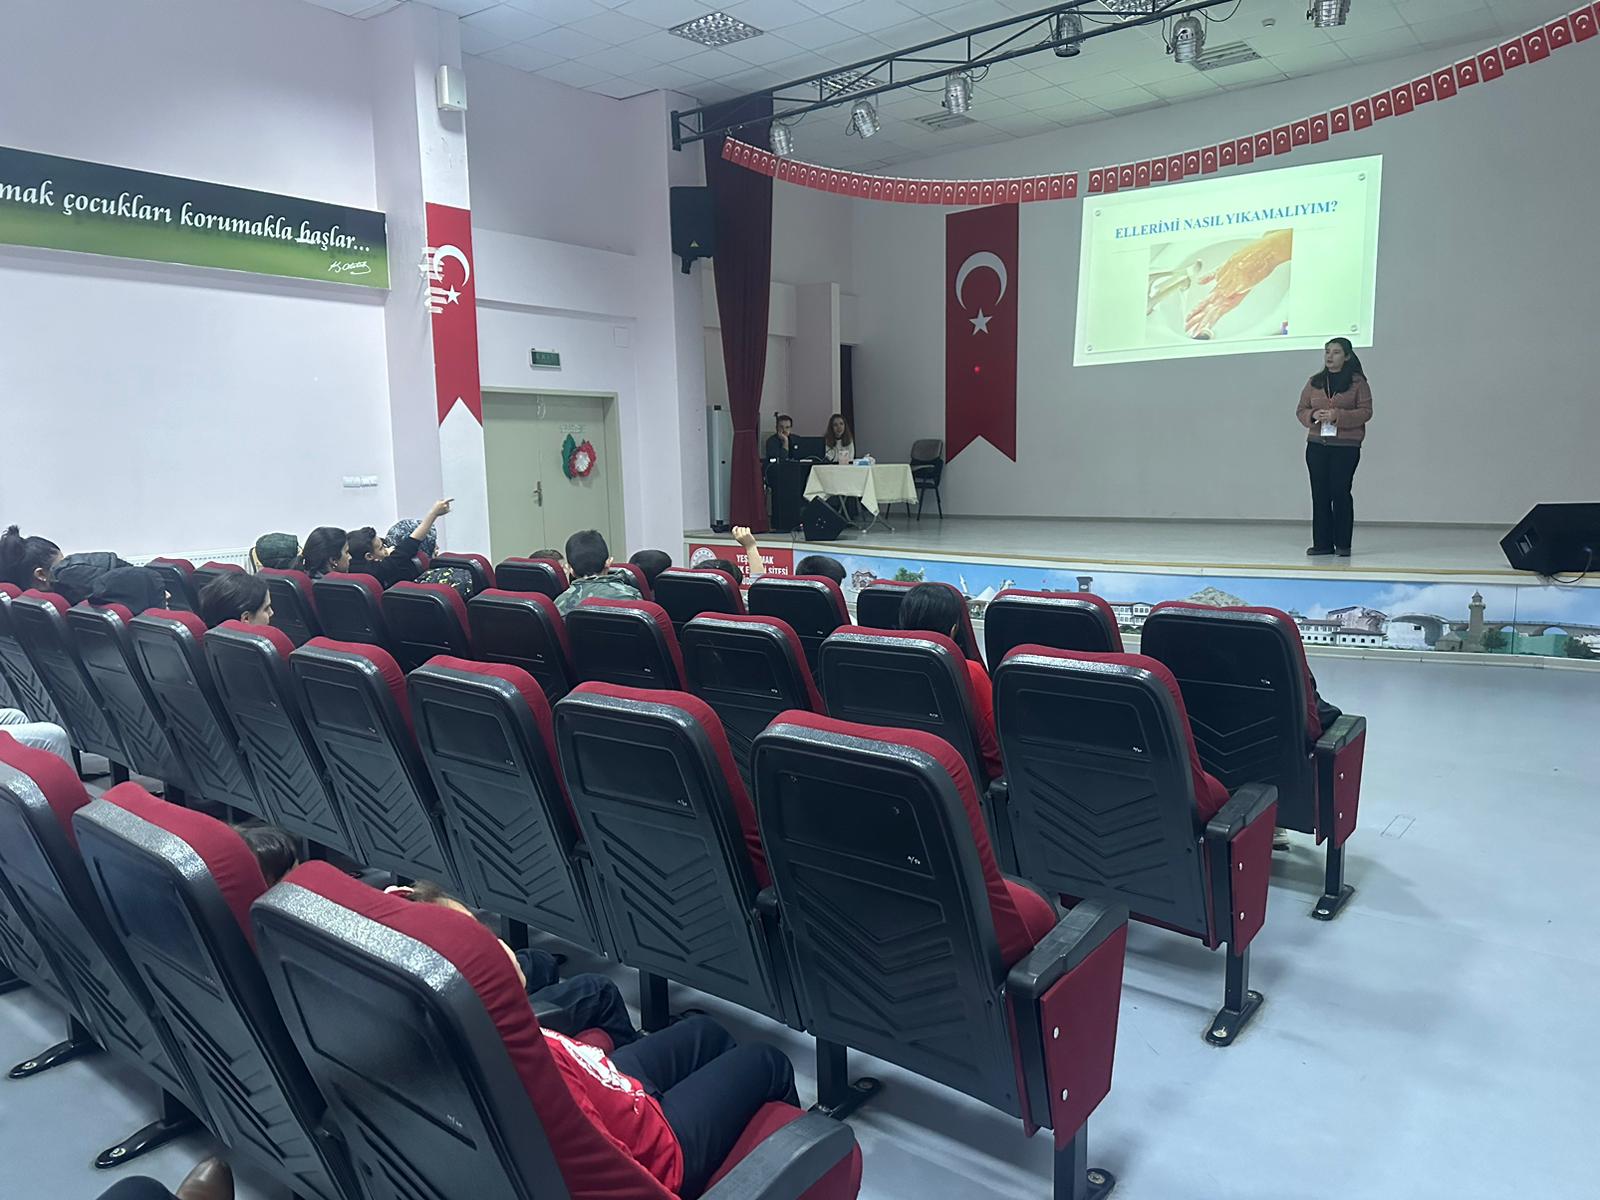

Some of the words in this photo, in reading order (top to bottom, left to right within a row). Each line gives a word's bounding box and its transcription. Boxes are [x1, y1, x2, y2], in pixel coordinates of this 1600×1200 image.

[63, 192, 173, 223] çocukları
[180, 202, 294, 240] korumakla
[300, 220, 371, 252] başlar...
[1115, 218, 1180, 239] ELLERİMİ
[1183, 211, 1224, 230] NASIL
[1225, 201, 1339, 225] YIKAMALIYIM?
